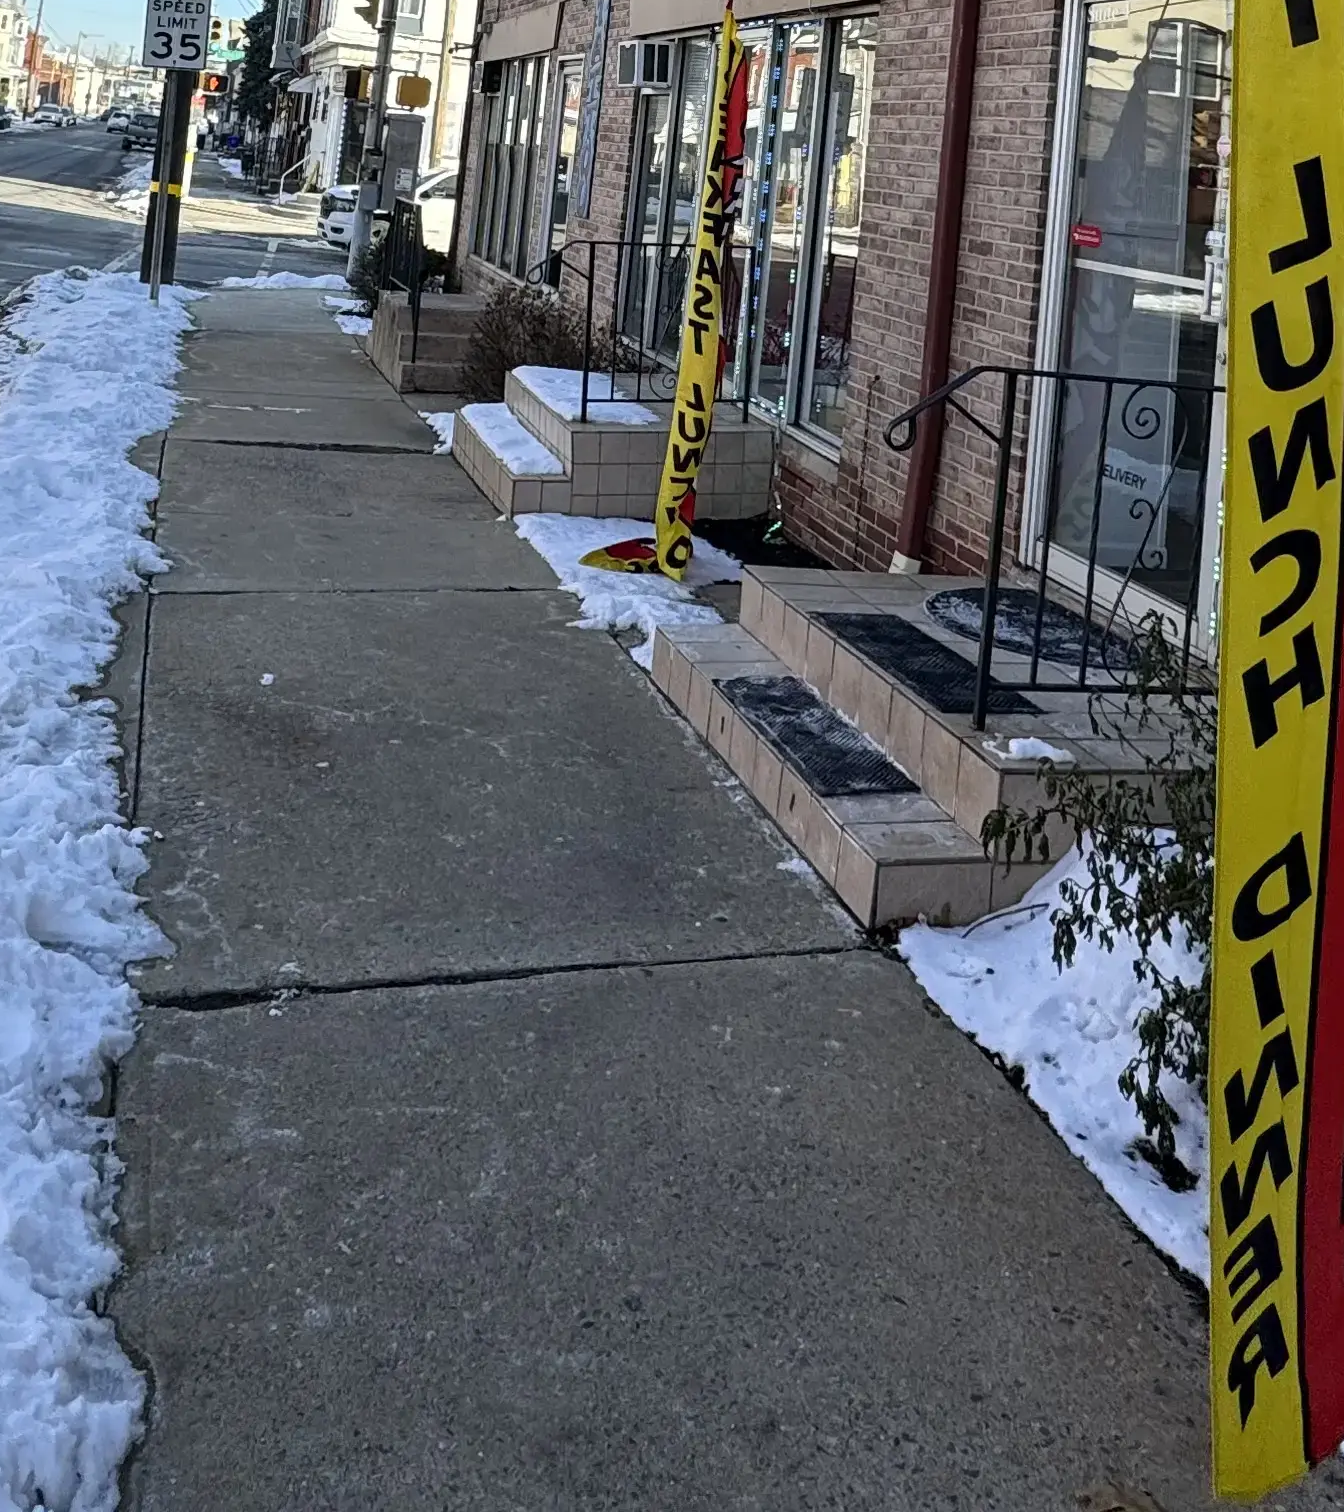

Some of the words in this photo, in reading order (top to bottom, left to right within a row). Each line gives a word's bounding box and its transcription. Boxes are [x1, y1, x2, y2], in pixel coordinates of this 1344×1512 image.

[157, 15, 198, 30] LIMIT
[150, 31, 202, 61] 35
[1102, 463, 1147, 490] ELIVERY
